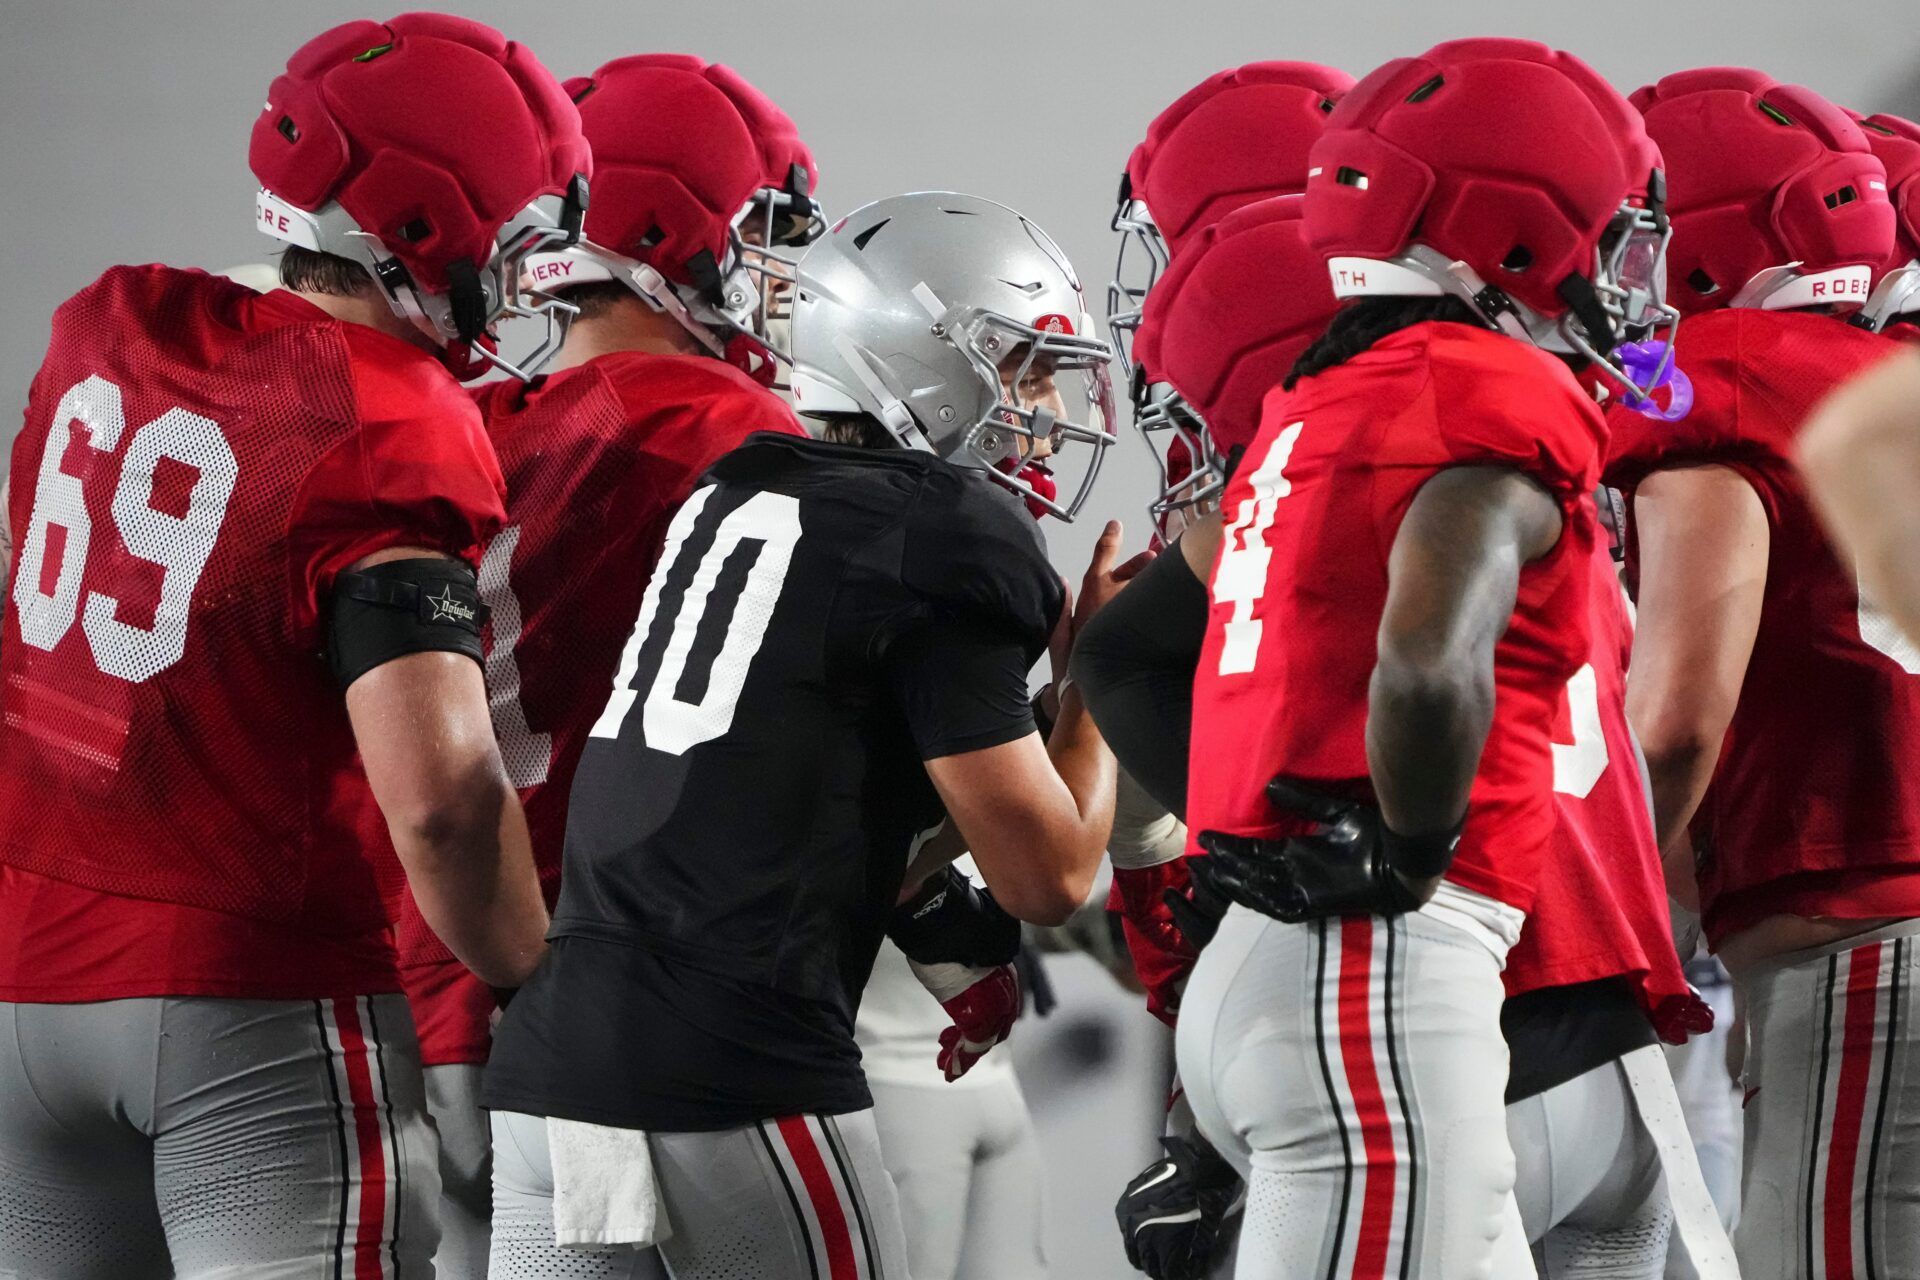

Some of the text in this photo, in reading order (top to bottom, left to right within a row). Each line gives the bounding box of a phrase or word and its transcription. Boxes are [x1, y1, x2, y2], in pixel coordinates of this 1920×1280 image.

[1813, 280, 1867, 297] ROBE
[13, 374, 239, 683] 69
[441, 600, 474, 620] Douglas
[588, 484, 802, 756] 10
[1213, 421, 1304, 676] 4
